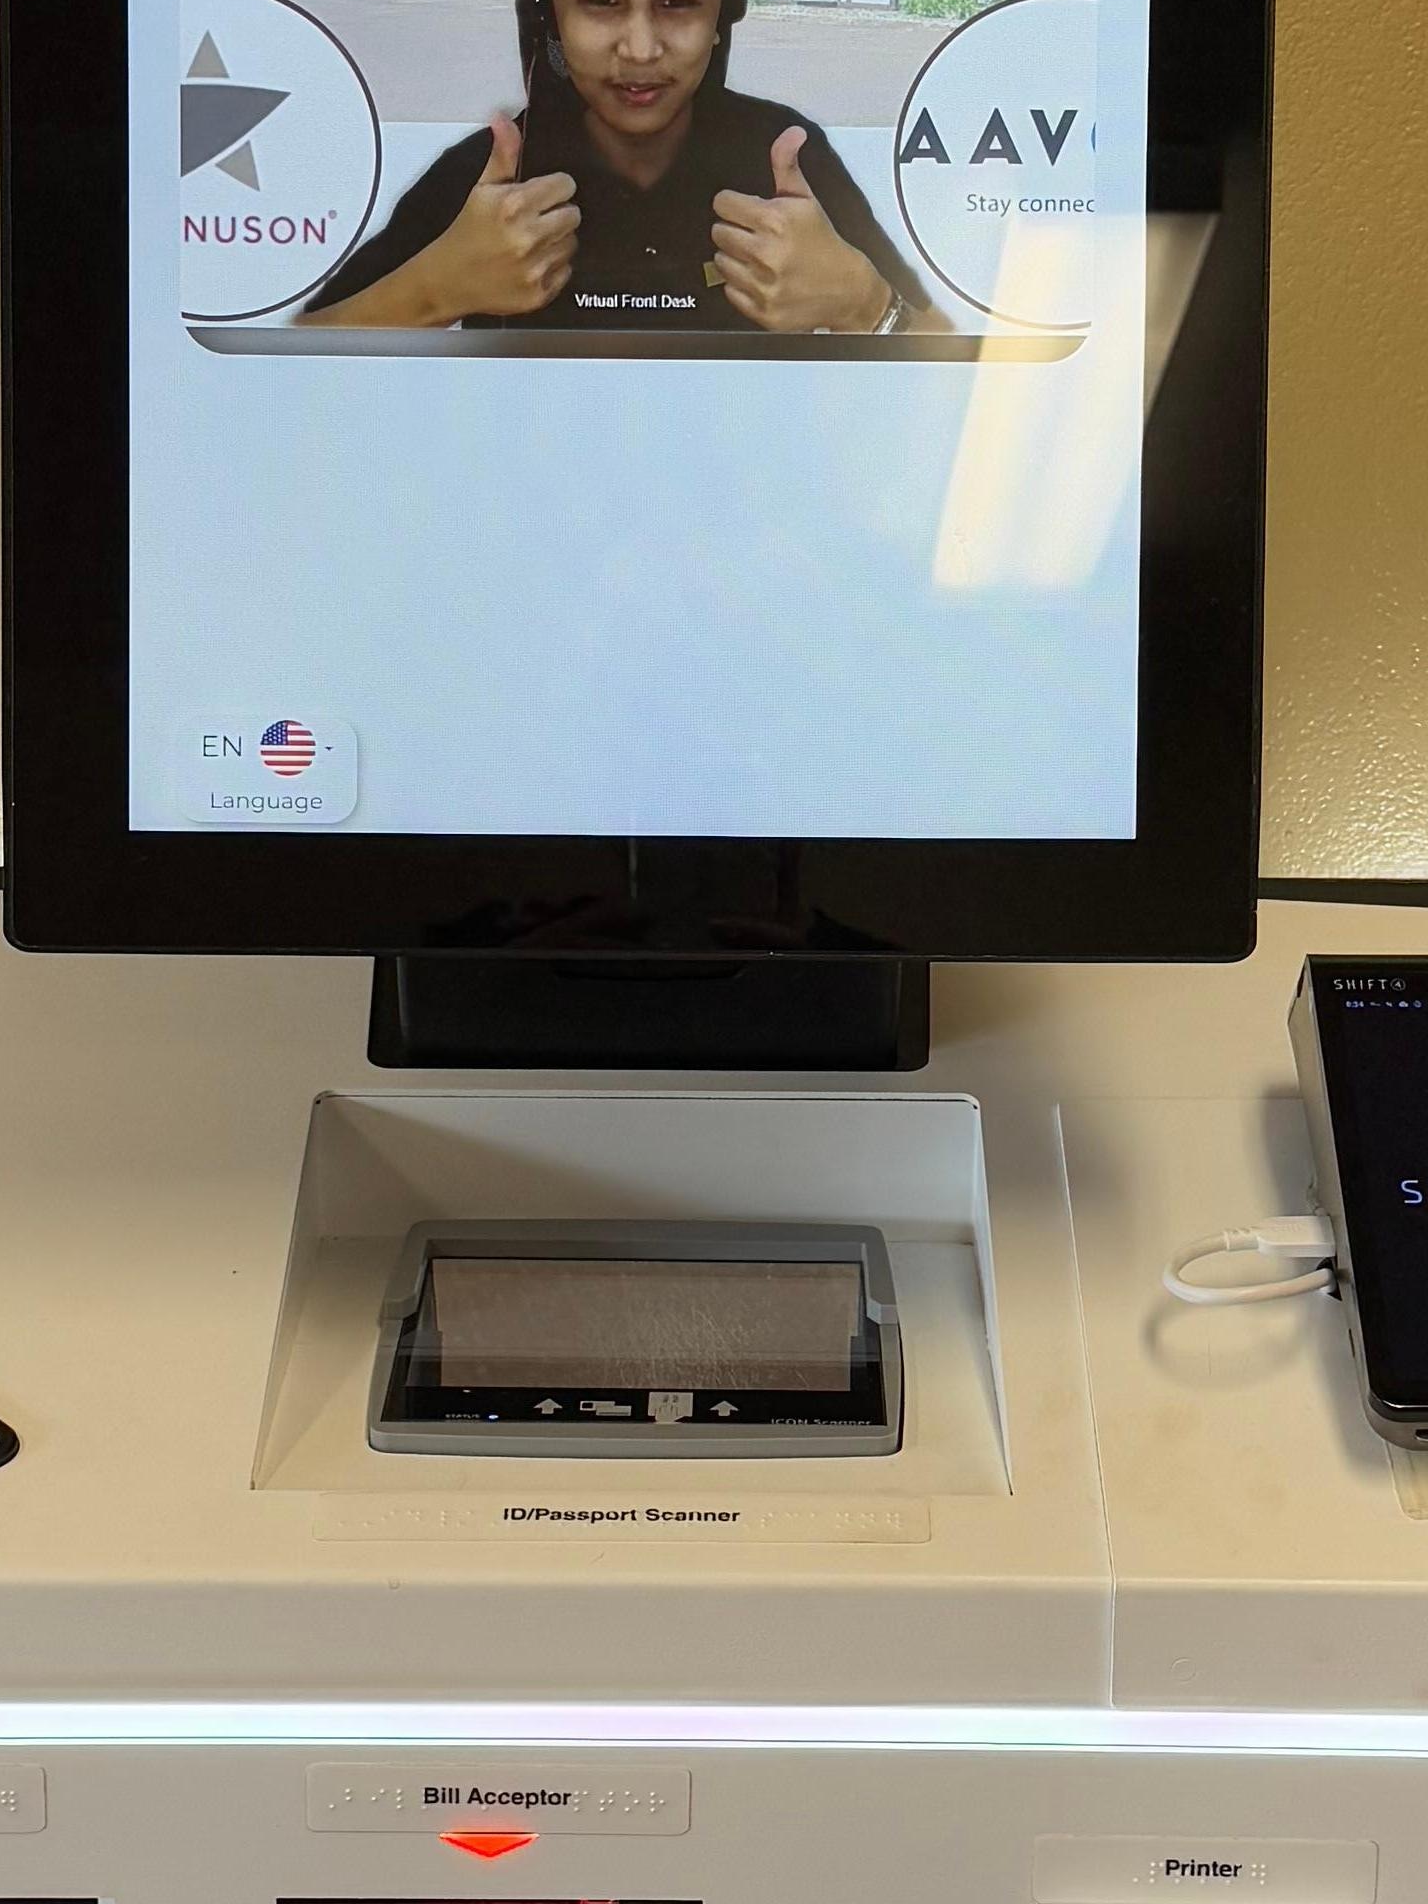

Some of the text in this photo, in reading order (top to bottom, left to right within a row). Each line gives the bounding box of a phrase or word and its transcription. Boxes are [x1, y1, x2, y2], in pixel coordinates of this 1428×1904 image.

[899, 106, 1096, 167] AAV
[967, 193, 1011, 217] Stay
[574, 293, 697, 309] Virtual Front Desk
[202, 735, 243, 758] EN
[210, 791, 323, 814] Language
[502, 1507, 741, 1525] ID/Passport Scanner
[423, 1787, 572, 1809] Bill Acceptor
[1165, 1858, 1243, 1878] Printer
